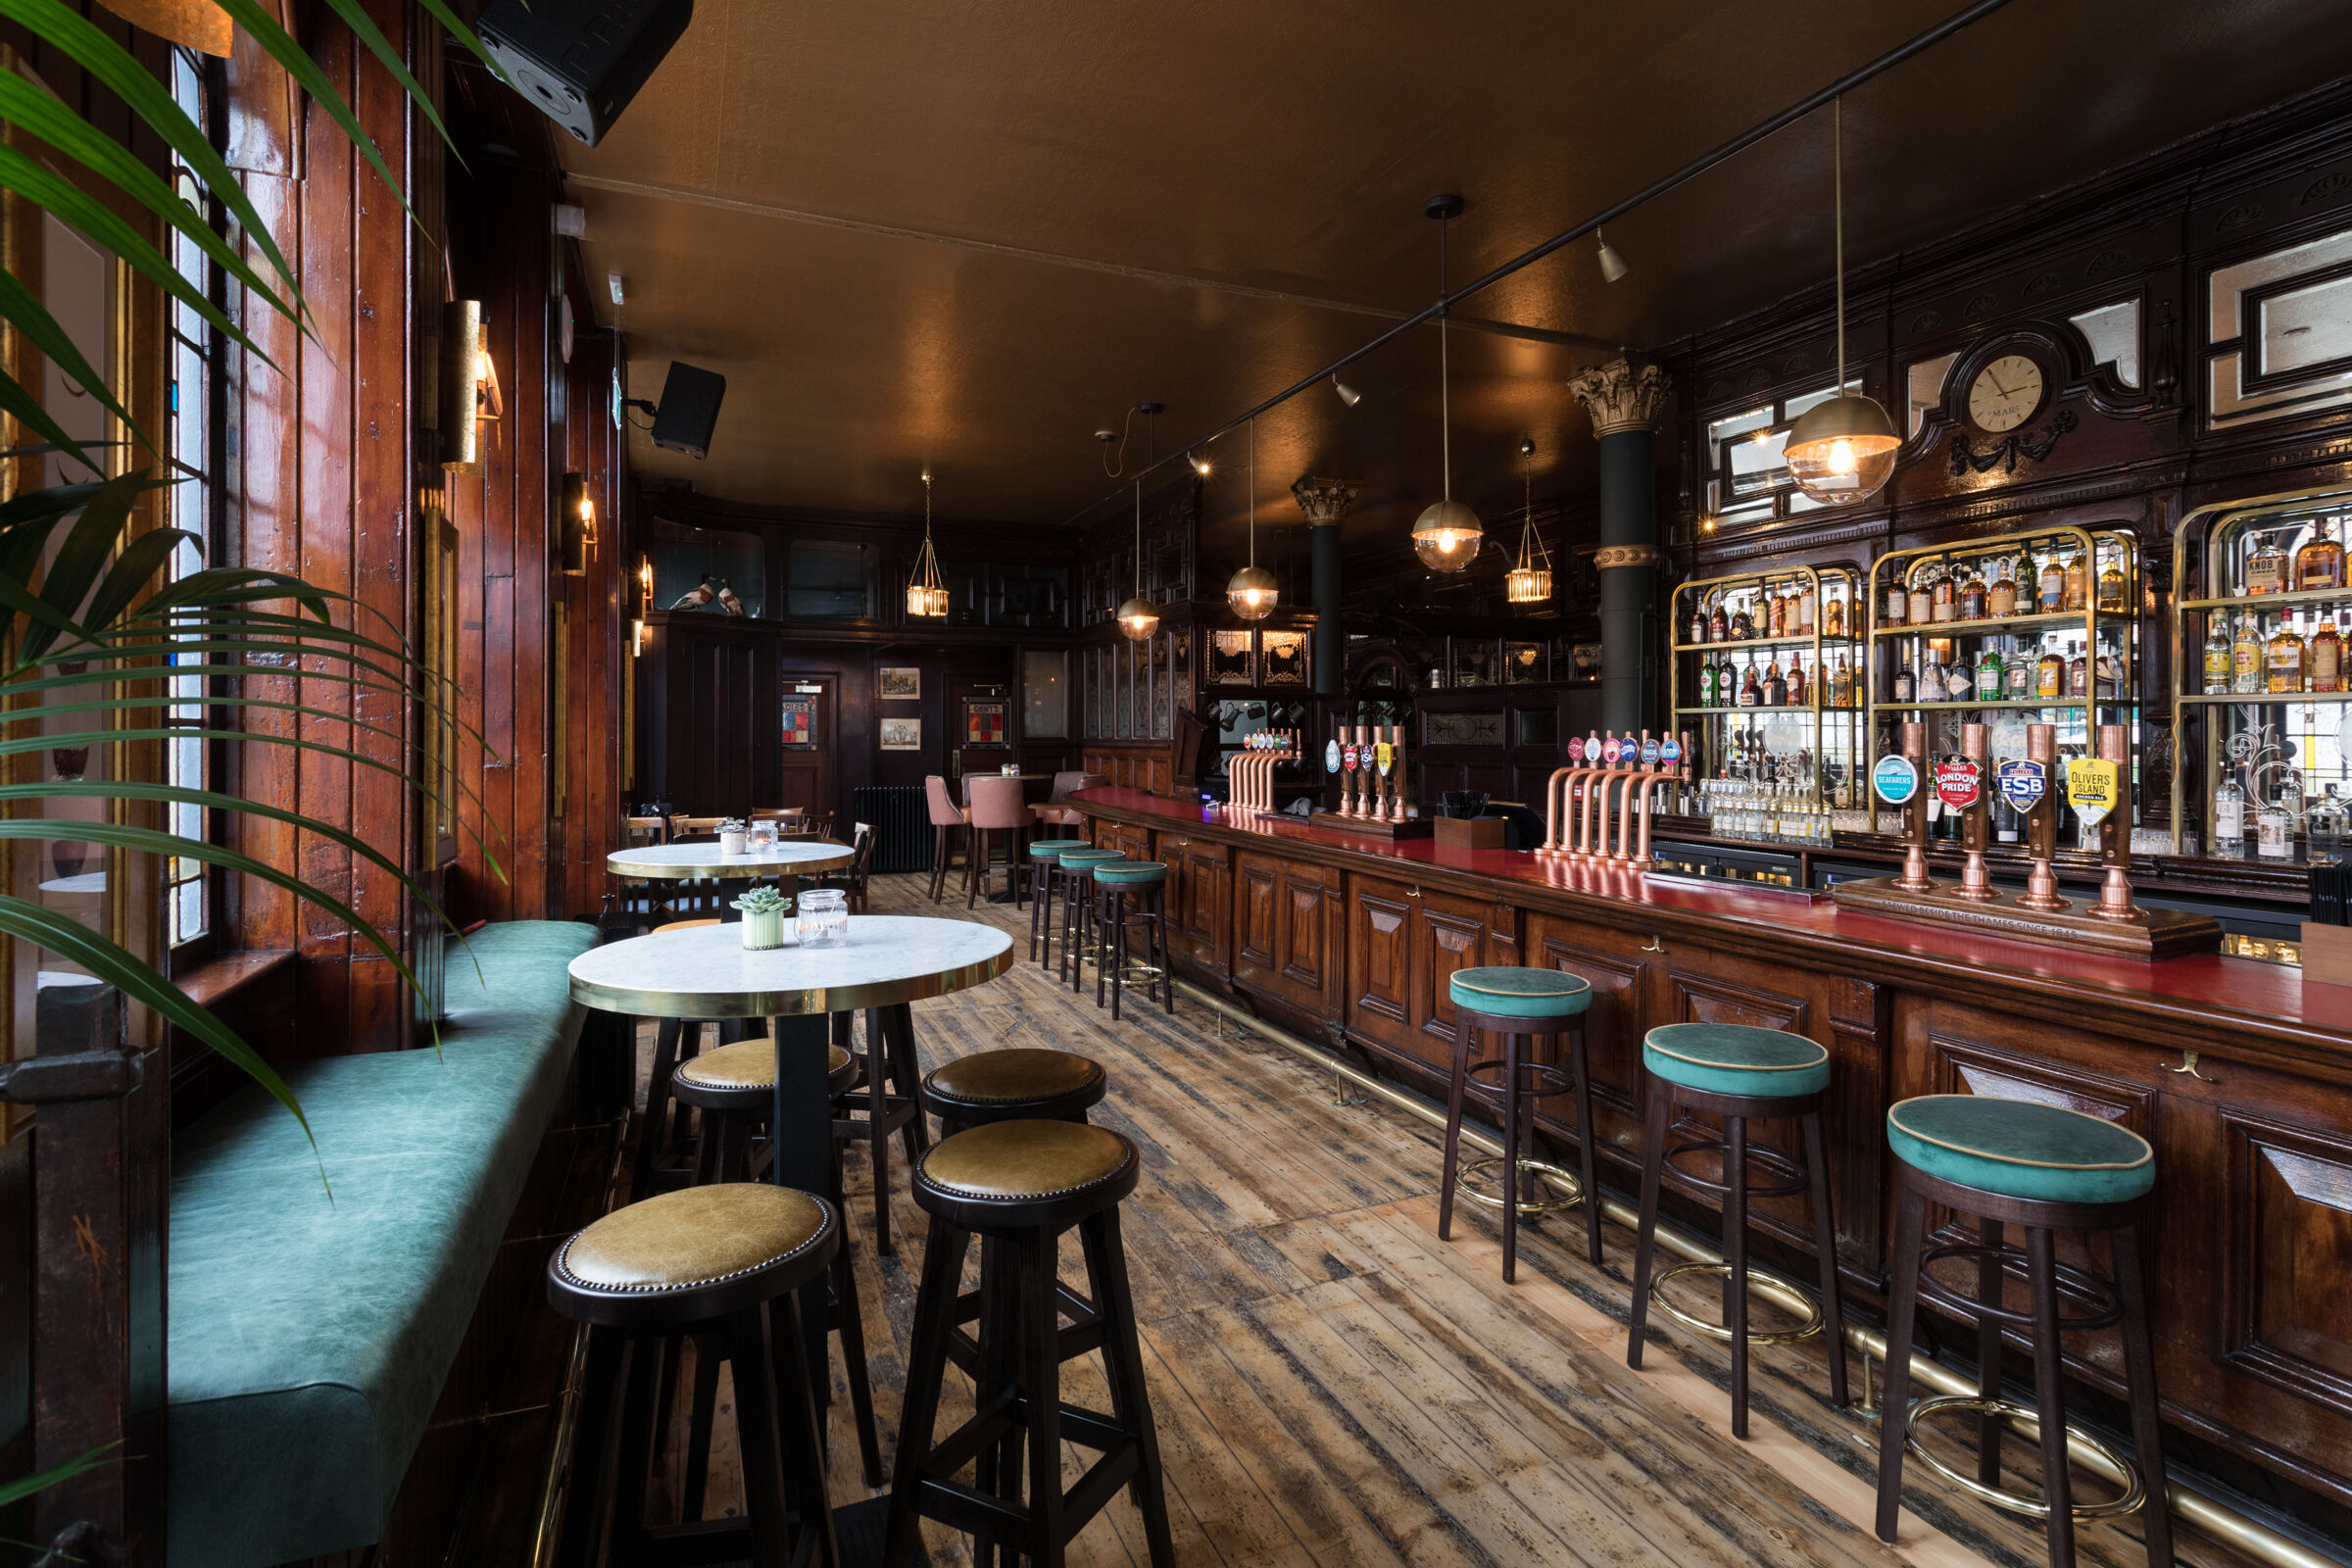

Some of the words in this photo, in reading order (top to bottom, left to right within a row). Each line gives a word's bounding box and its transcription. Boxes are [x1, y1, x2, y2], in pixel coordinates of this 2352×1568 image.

[2249, 560, 2274, 570] KNOB
[1878, 776, 1911, 785] SEAFARERS
[1935, 772, 1979, 786] LONDON
[1941, 783, 1972, 793] PRIDE
[2001, 777, 2043, 795] ESB
[2076, 784, 2105, 794] ISLAND
[1882, 901, 1916, 912] BREWED
[1919, 906, 1950, 919] BESIDE
[1952, 911, 1971, 922] THE
[1972, 914, 2015, 928] THAMES
[2017, 922, 2047, 934] SINCE
[2051, 928, 2078, 939] 1845
